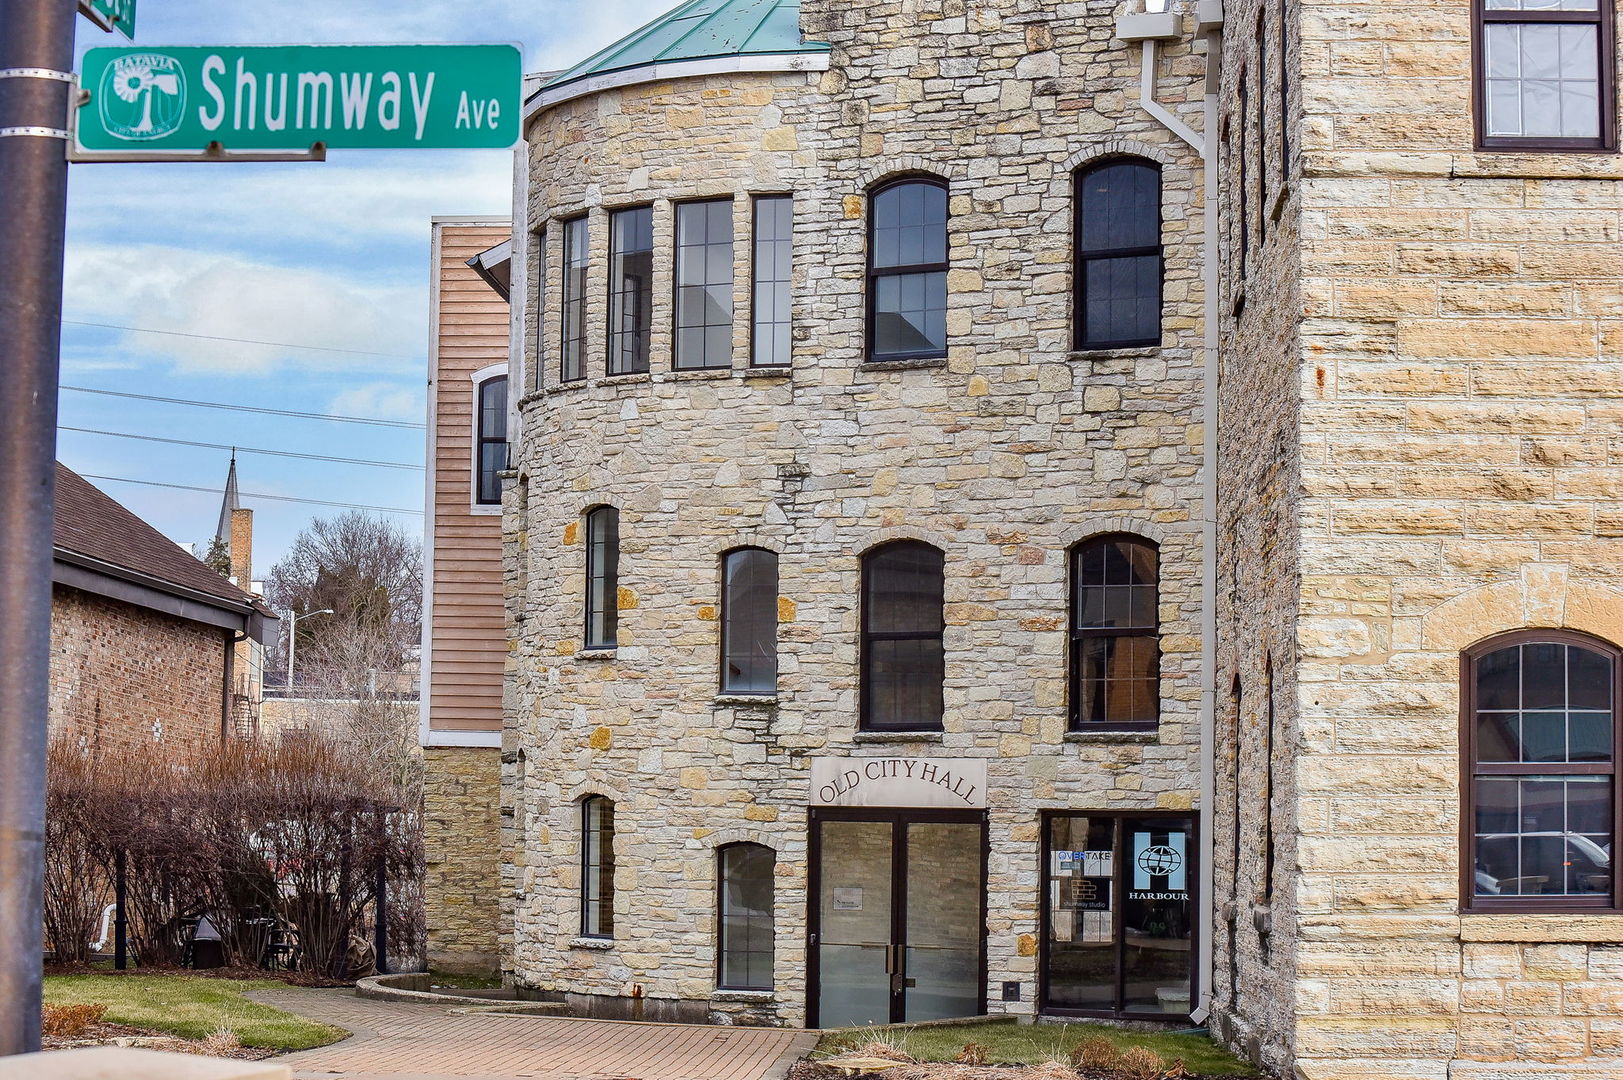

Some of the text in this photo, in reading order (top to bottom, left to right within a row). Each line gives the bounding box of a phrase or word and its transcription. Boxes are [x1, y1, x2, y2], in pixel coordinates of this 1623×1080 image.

[199, 54, 500, 140] Shumway Ave
[819, 760, 977, 806] OLD CITY HALL
[1059, 851, 1111, 860] OVERTAKE
[1129, 892, 1189, 900] HARBOUR
